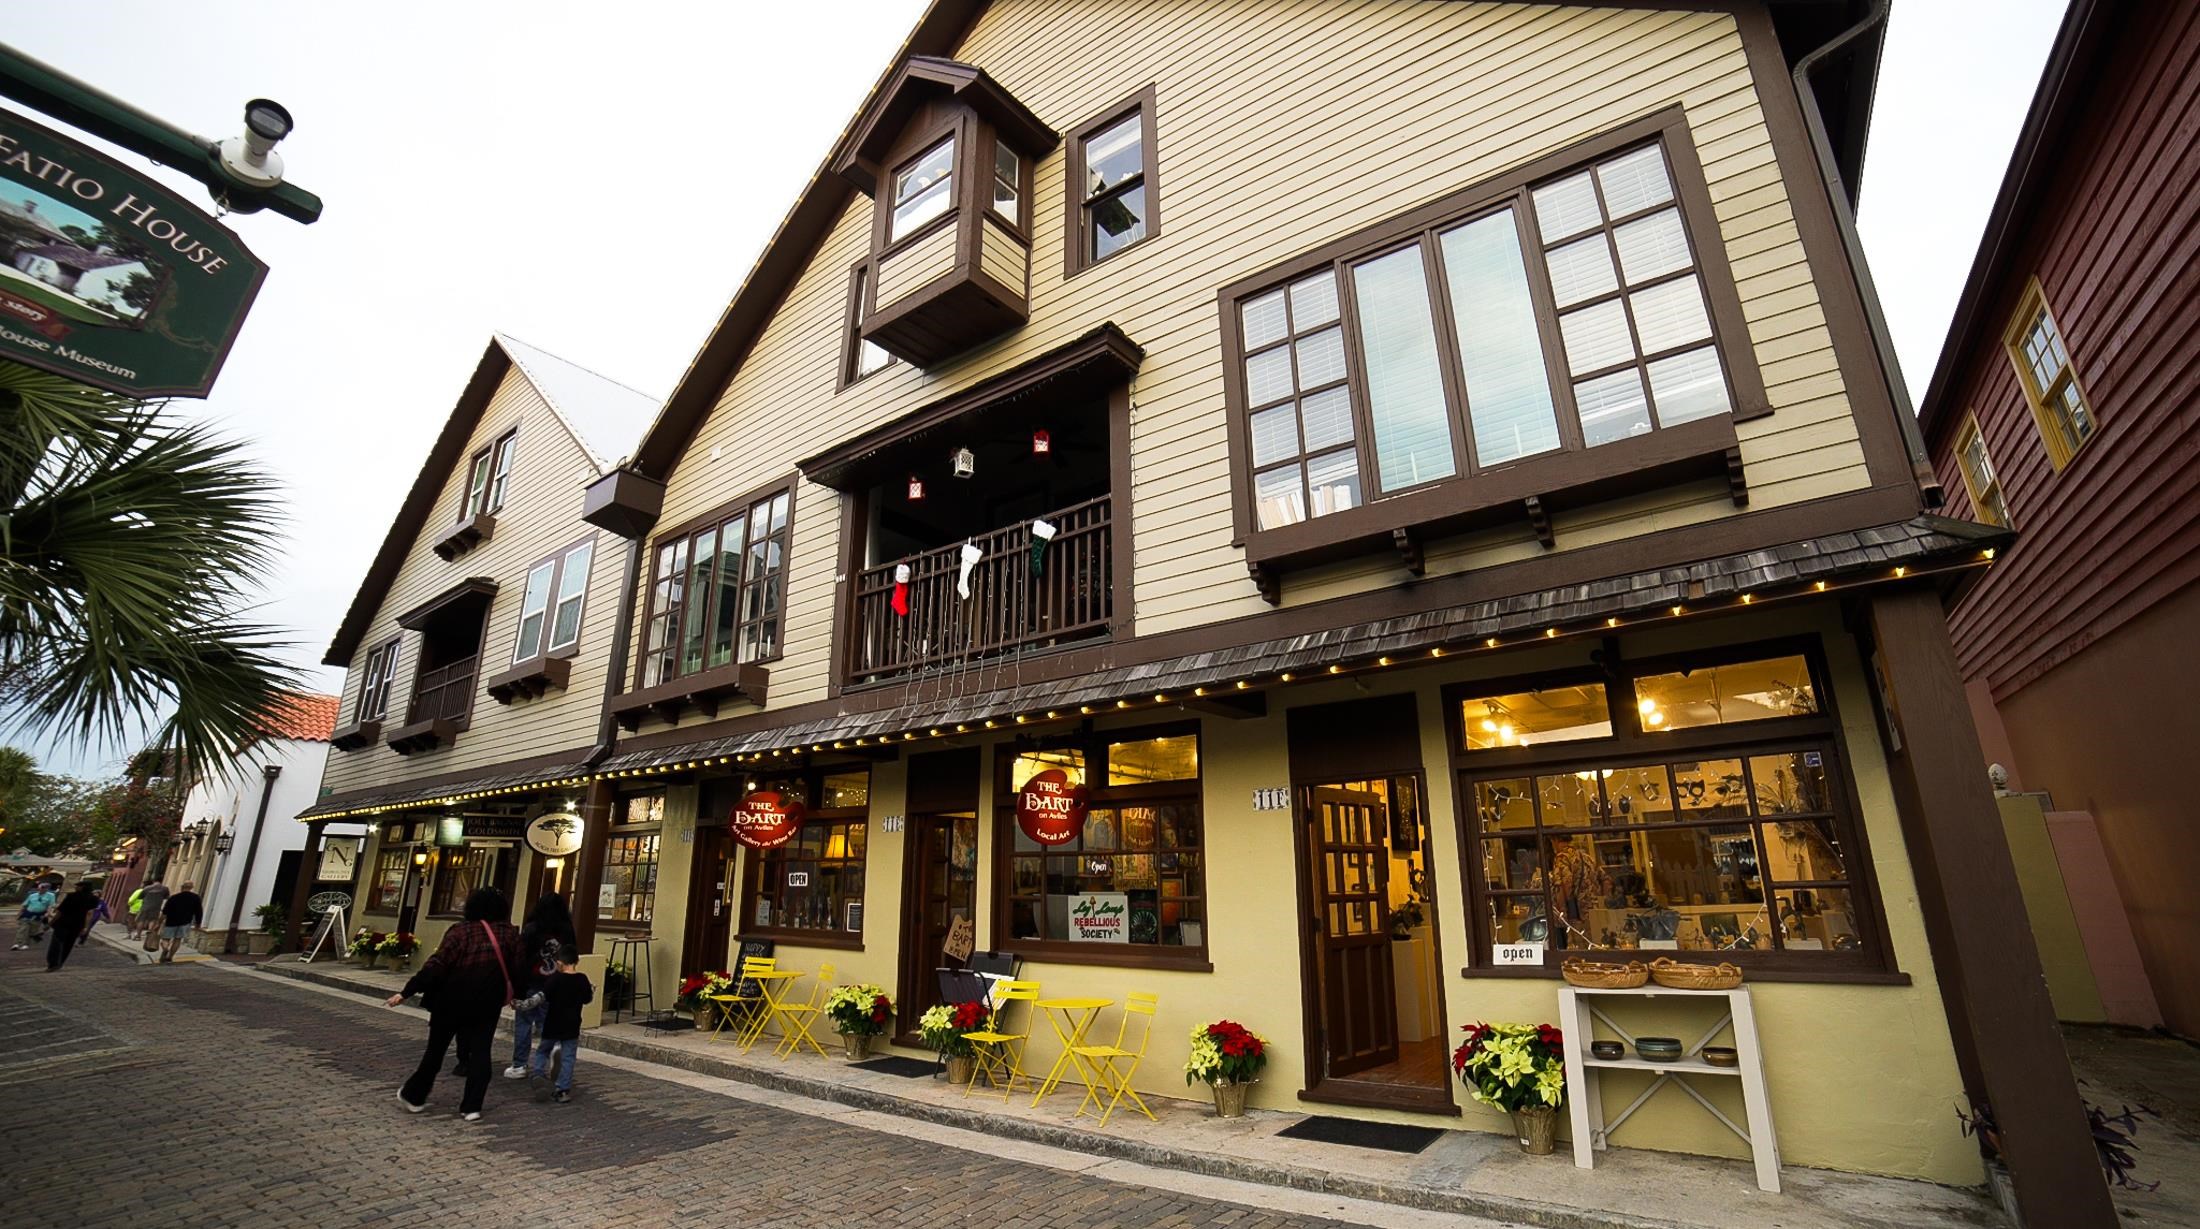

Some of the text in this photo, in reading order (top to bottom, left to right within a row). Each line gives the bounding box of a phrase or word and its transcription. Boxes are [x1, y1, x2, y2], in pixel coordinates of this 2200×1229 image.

[109, 193, 229, 275] HOUSE
[0, 324, 137, 380] ouse Museum
[1037, 781, 1062, 794] THE
[748, 802, 775, 812] THE
[1025, 792, 1073, 813] BART
[734, 810, 785, 826] BART
[468, 827, 520, 836] GOLDSMITH
[740, 833, 761, 847] Gallery
[772, 835, 788, 845] Wine
[788, 826, 797, 836] Bar
[1036, 828, 1070, 840] Local Art
[1091, 861, 1107, 874] Open
[790, 874, 807, 885] OPEN
[1074, 917, 1121, 927] REBELLIOUS
[1080, 929, 1113, 939] SOCIETY
[1503, 948, 1533, 962] open
